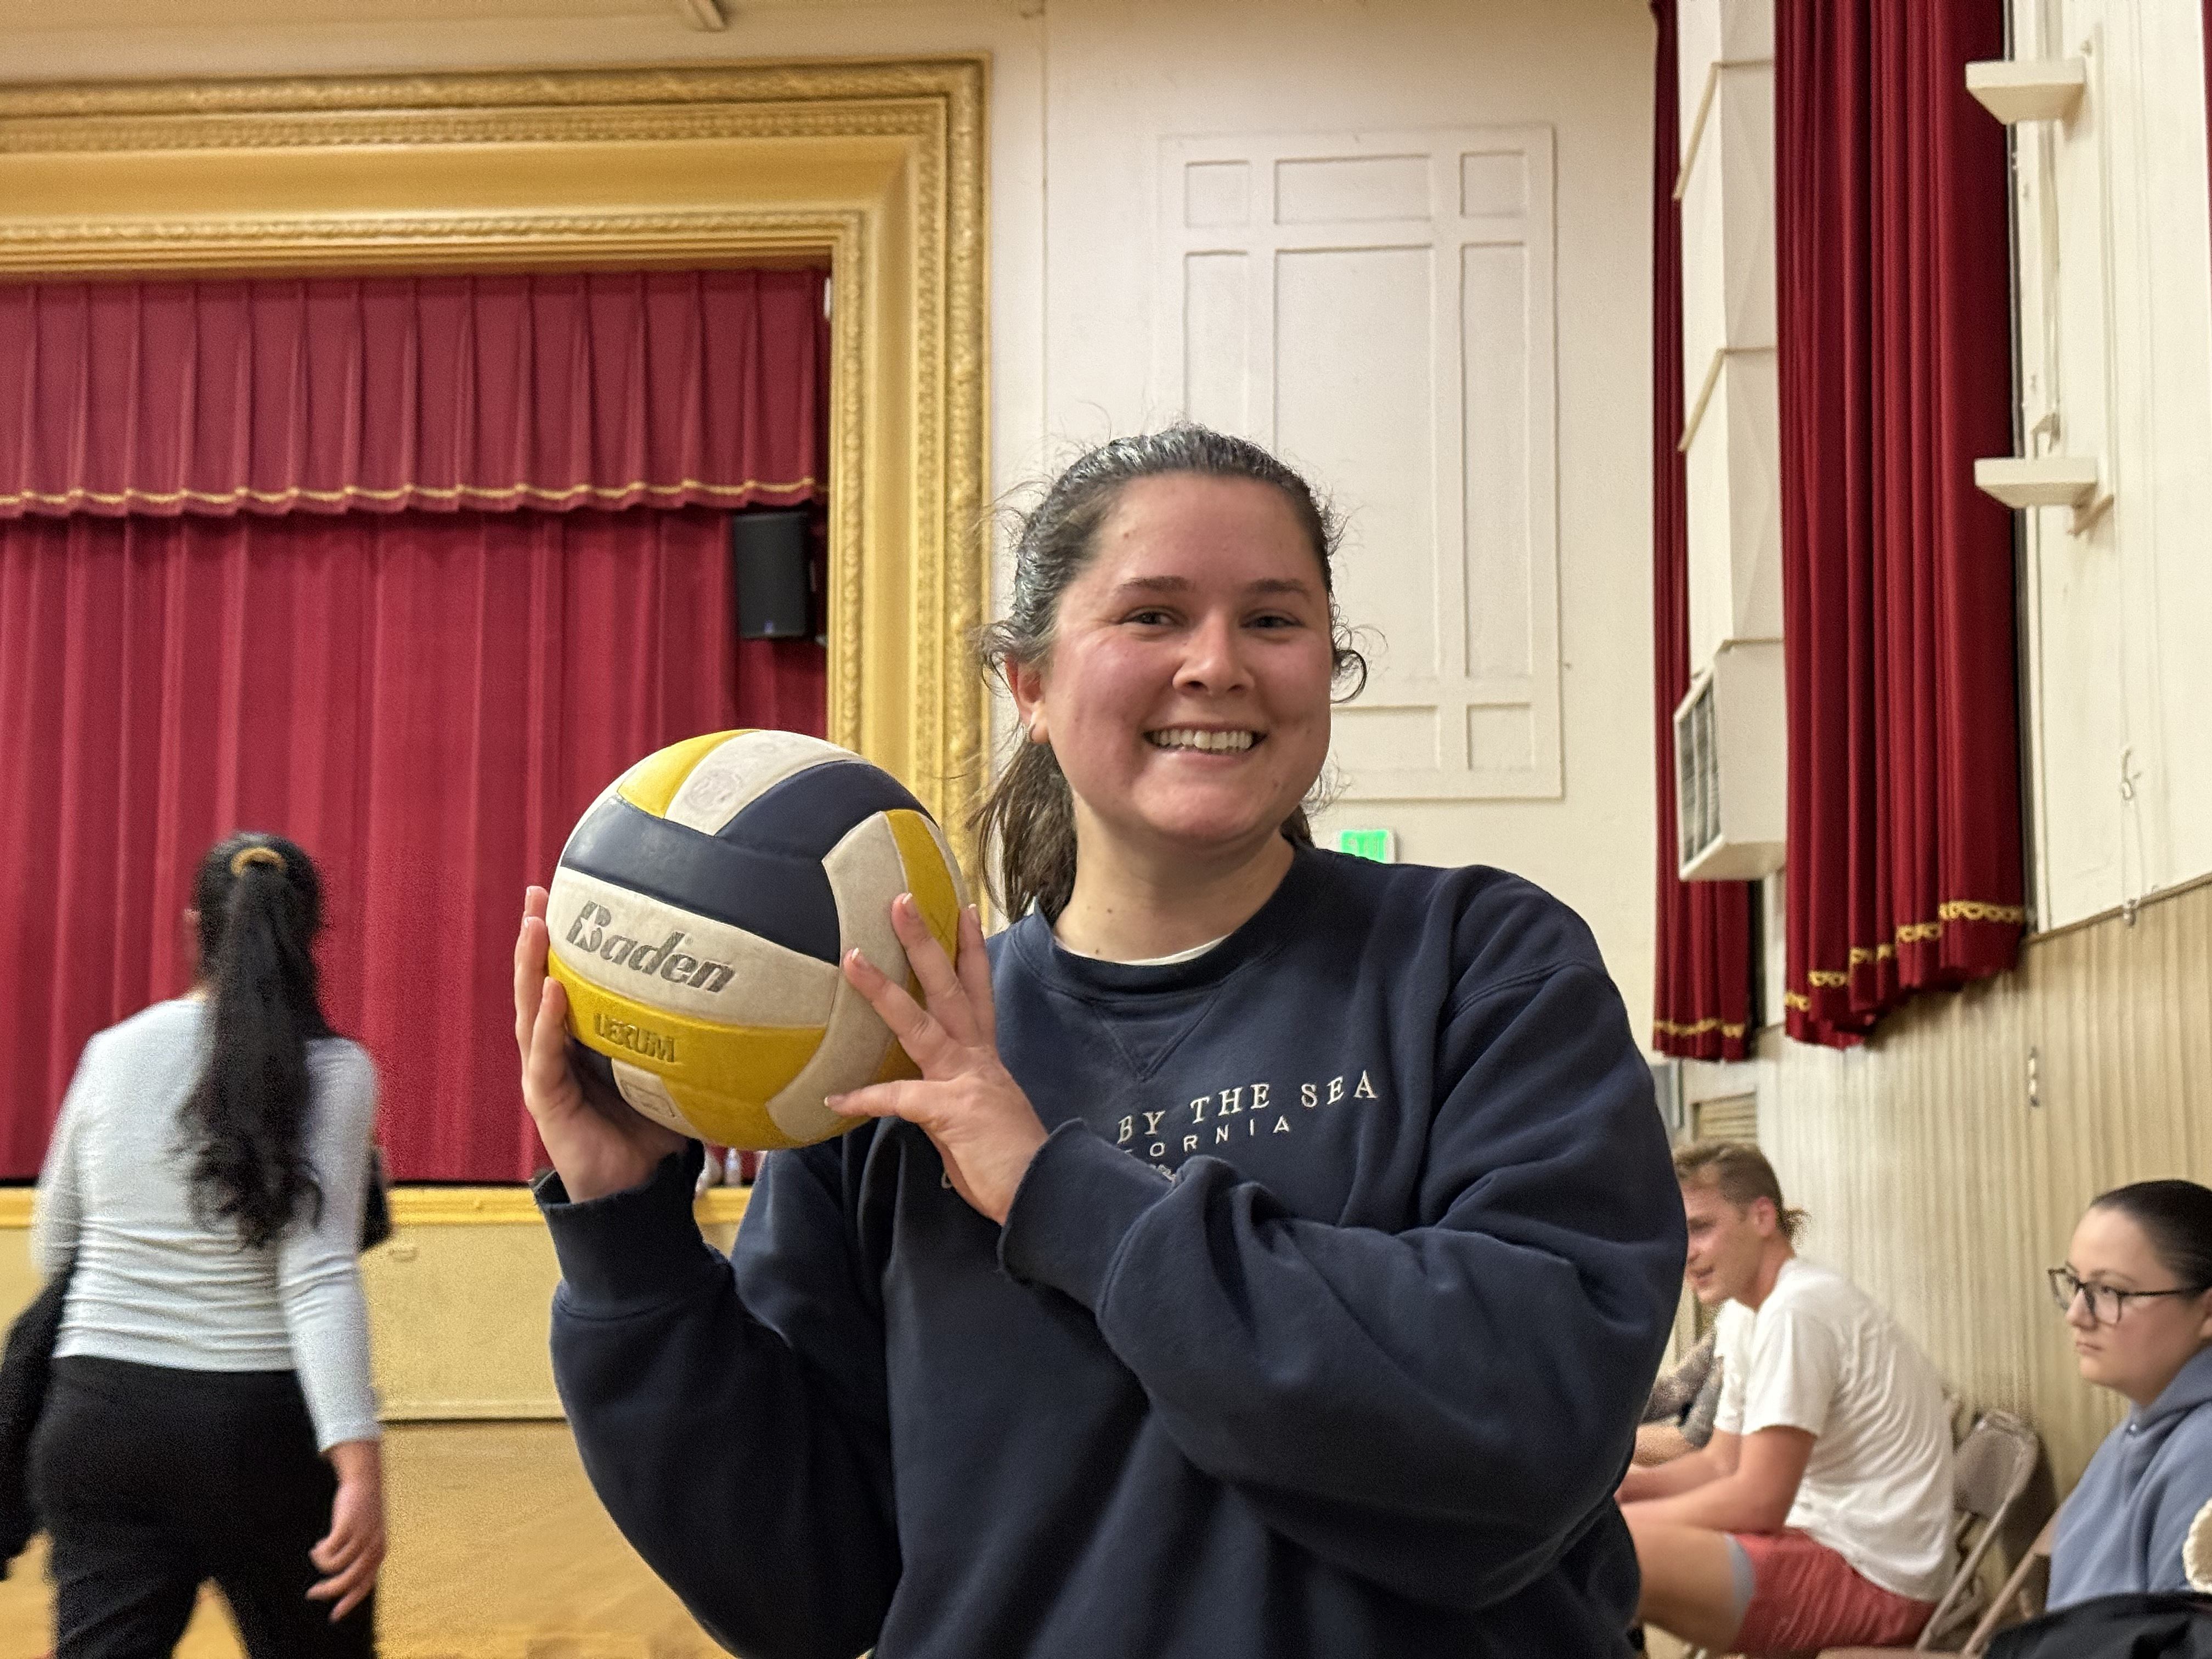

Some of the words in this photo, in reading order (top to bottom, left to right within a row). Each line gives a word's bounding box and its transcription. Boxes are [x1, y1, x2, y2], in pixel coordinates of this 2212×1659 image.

[566, 900, 735, 992] Baden
[1117, 1110, 1166, 1145] BY
[1190, 1084, 1270, 1124] THE
[1301, 1070, 1379, 1108] SEA
